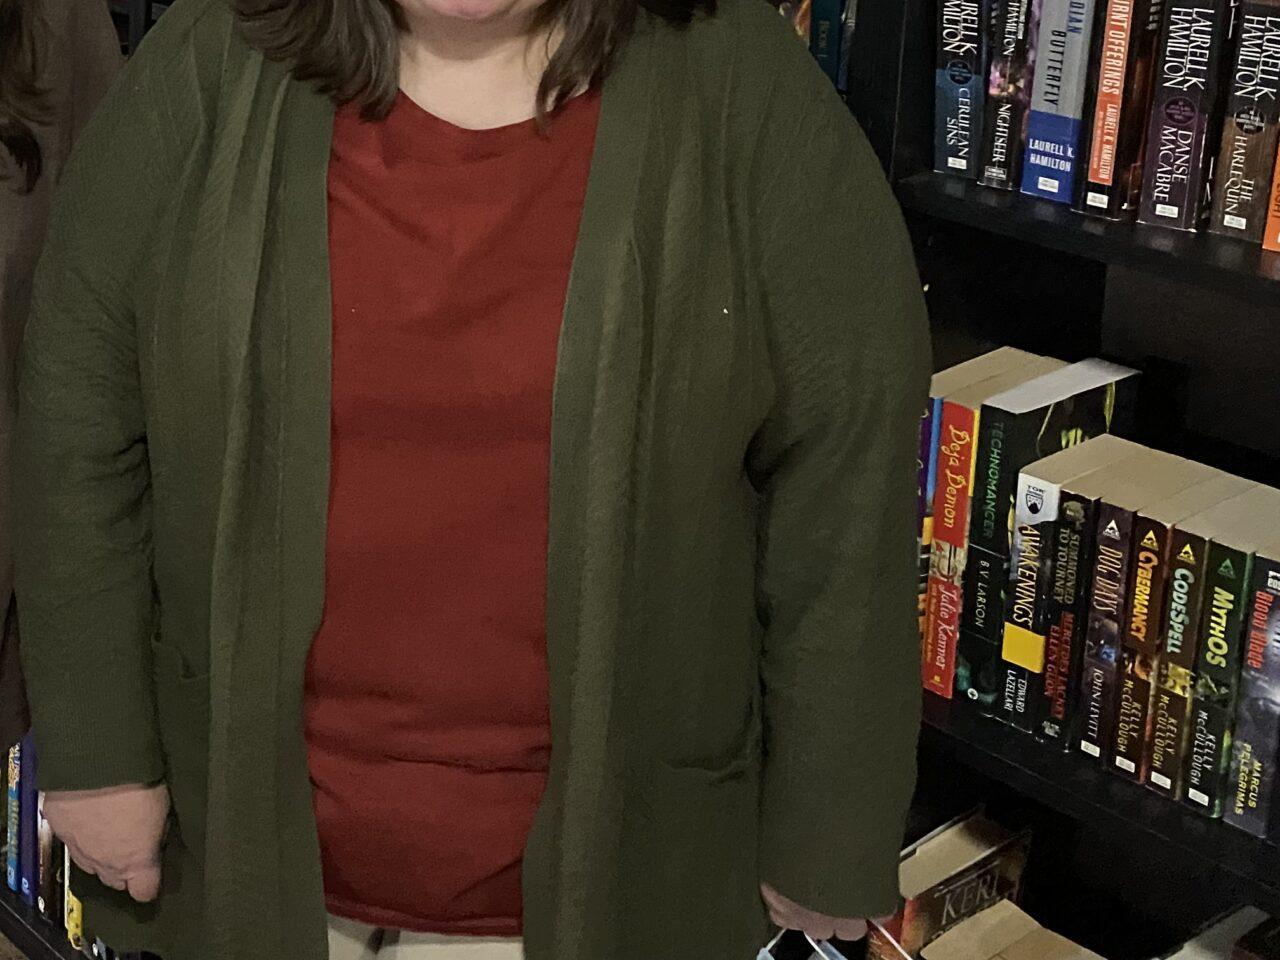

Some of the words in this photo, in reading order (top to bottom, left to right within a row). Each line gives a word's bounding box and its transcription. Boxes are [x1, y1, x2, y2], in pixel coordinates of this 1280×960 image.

[1101, 29, 1128, 96] OFFERINGS
[1162, 7, 1193, 90] HAMILTON
[1186, 7, 1215, 76] LAURELL
[1234, 14, 1266, 99] HAMILTON
[1043, 29, 1067, 106] BUTTERFLY
[947, 116, 960, 146] SINS
[958, 87, 971, 158] CERULEAN
[991, 103, 1012, 162] NIGHTSEER
[1029, 138, 1064, 156] LAURELL
[1030, 153, 1071, 172] HAMILTON
[1152, 125, 1178, 203] MACABRE
[1171, 129, 1193, 184] DANSE
[1224, 135, 1248, 214] HARLEQUIN
[1240, 179, 1254, 203] THE
[940, 424, 970, 468] Deja
[943, 474, 968, 529] Demon
[982, 421, 1003, 539] TECHNOMANCER
[1013, 526, 1041, 626] AWAKENINGS
[1100, 544, 1123, 574] DOG
[940, 581, 959, 621] Julie
[974, 585, 987, 628] LARSON
[1092, 574, 1119, 615] DAYS
[936, 622, 952, 670] Kenner
[1205, 586, 1235, 668] MYTHOS
[1004, 669, 1016, 711] LAZELLARI
[1016, 678, 1027, 714] EDWARD
[1091, 668, 1104, 702] JOHN
[1086, 702, 1099, 739] LEVITT
[1234, 742, 1252, 816] PELEGRIMAS
[1248, 761, 1262, 809] MARCUS
